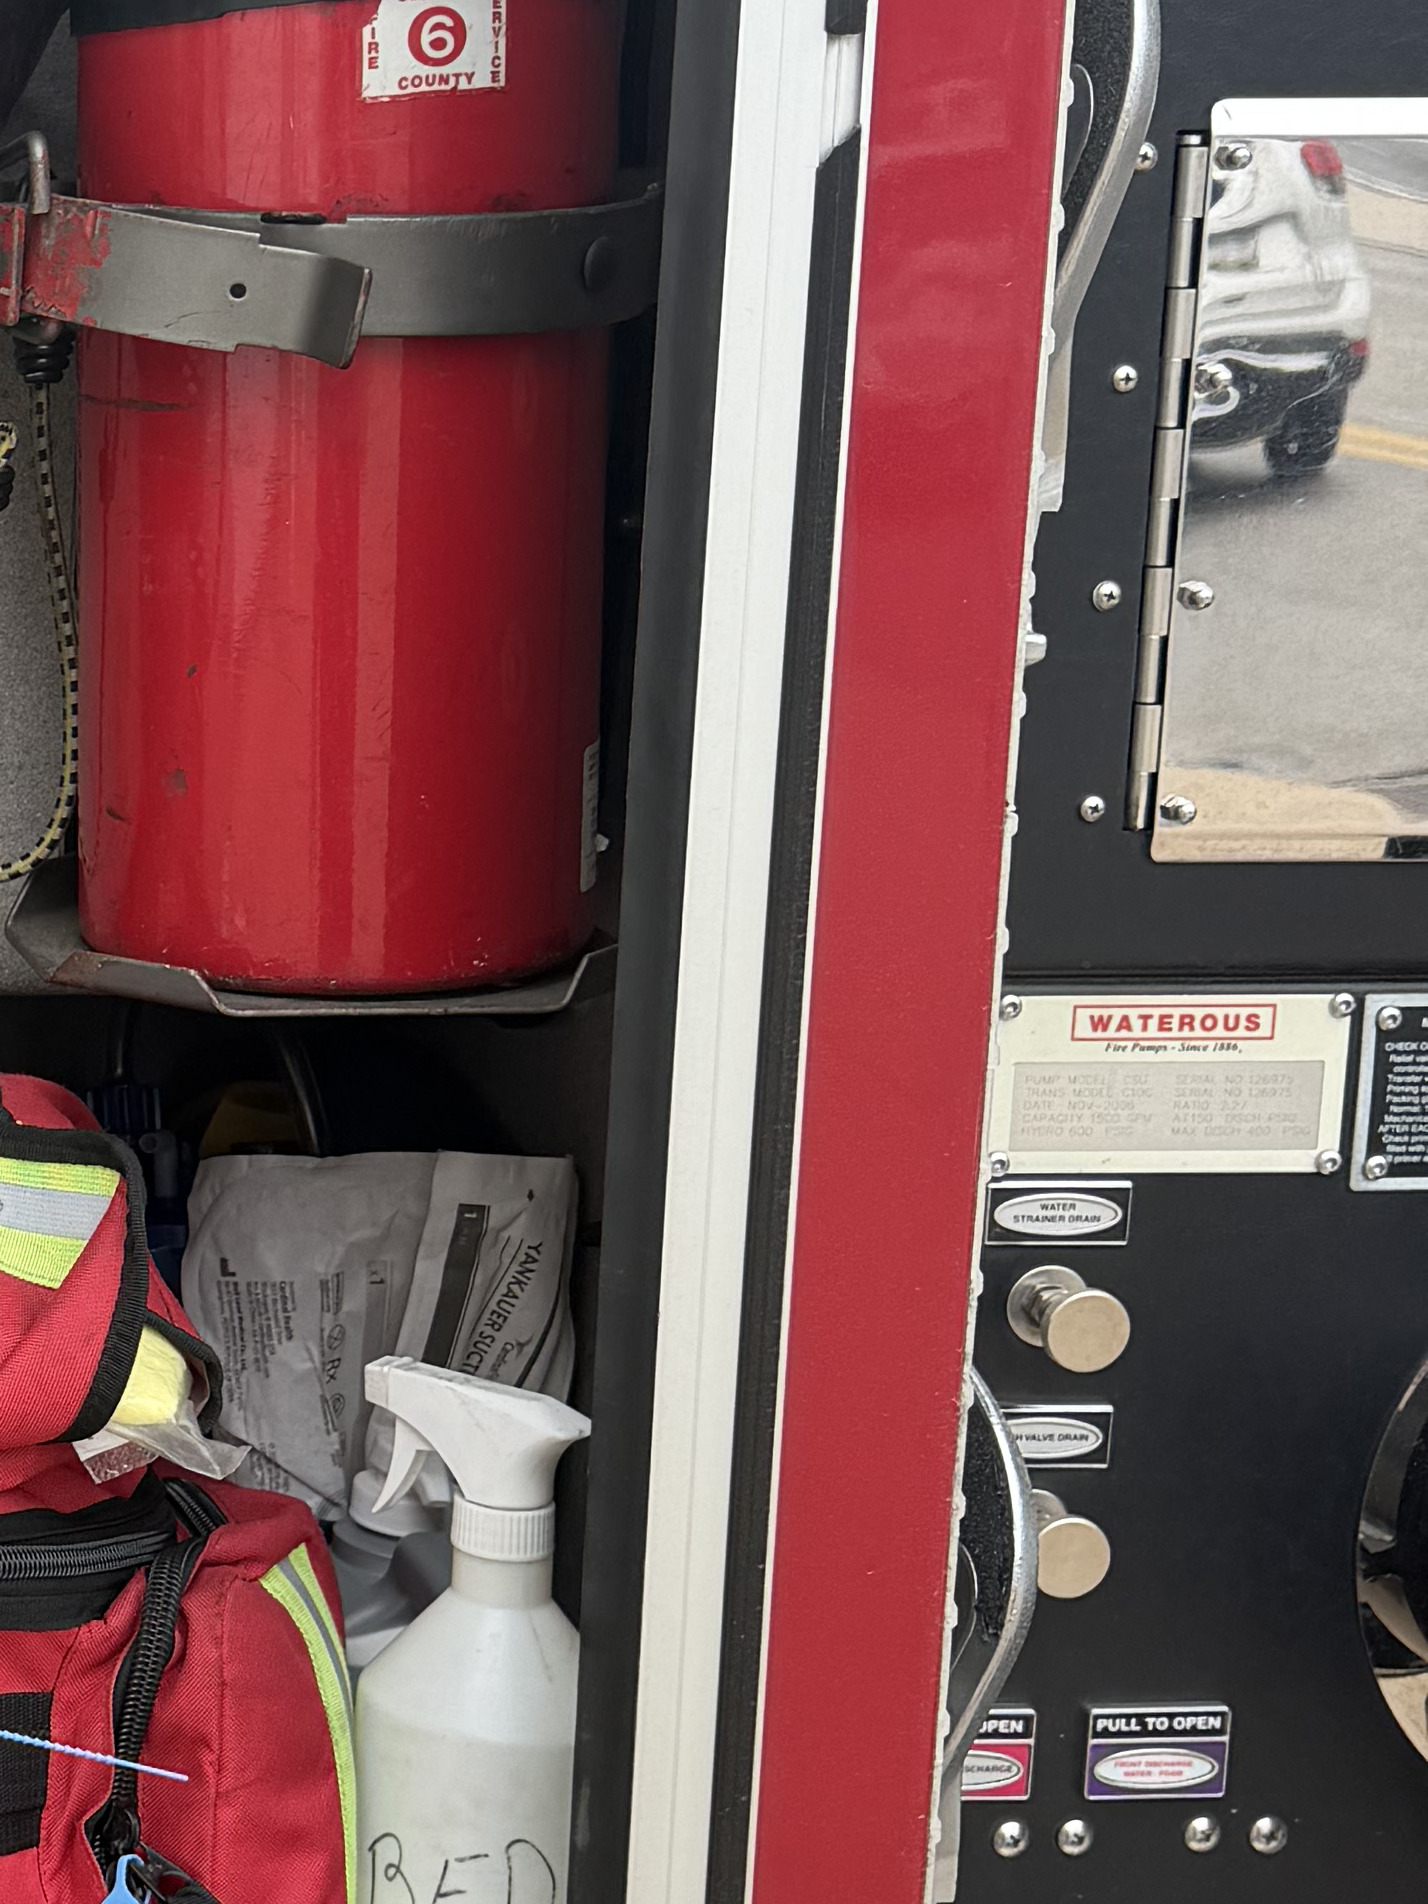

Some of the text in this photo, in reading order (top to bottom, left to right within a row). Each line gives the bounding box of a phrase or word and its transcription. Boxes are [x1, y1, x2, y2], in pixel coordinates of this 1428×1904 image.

[368, 26, 379, 70] IRE
[421, 14, 454, 59] 6
[398, 72, 476, 90] COUNTY
[1089, 1013, 1262, 1033] WATEROUS
[1105, 1043, 1129, 1053] Fire
[1131, 1043, 1169, 1054] Pumps
[1177, 1042, 1209, 1053] Since
[1040, 1203, 1077, 1212] WATER
[1013, 1214, 1101, 1224] STRAINER DRAIN
[481, 1241, 543, 1340] YANKAUER
[326, 1358, 343, 1384] Rx
[1023, 1433, 1089, 1442] VALVE DRAIN
[1096, 1717, 1221, 1732] PULL TO OPEN
[1145, 1760, 1193, 1768] DISCHARGE
